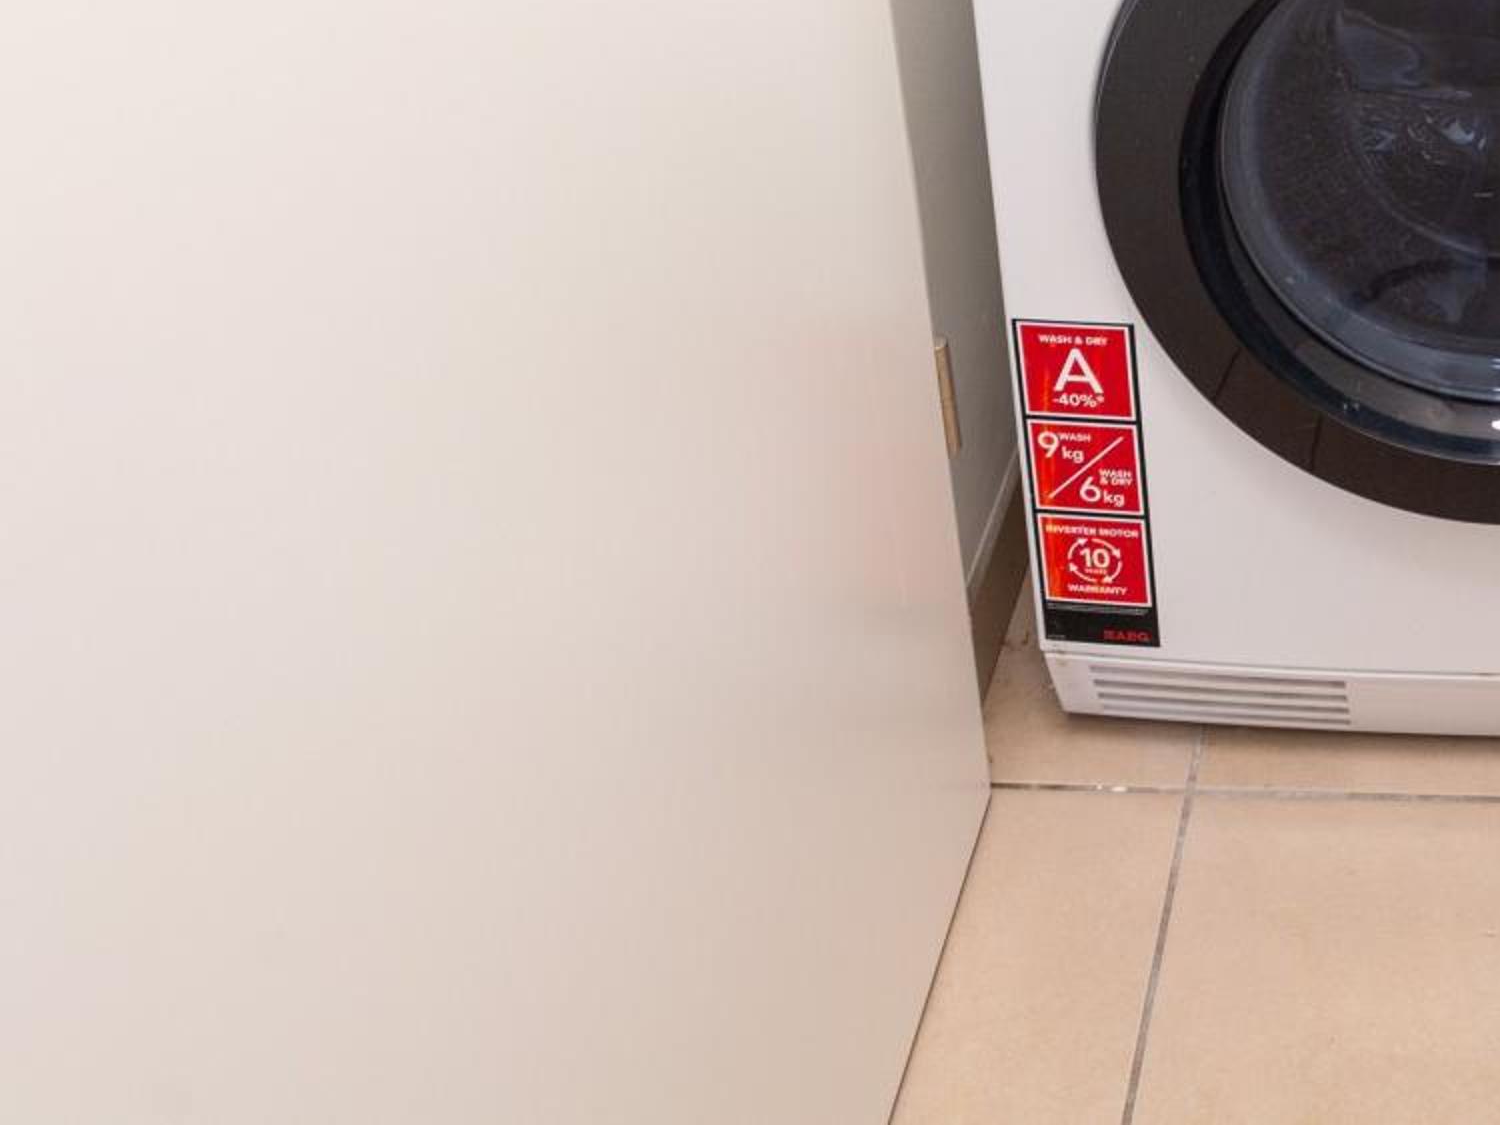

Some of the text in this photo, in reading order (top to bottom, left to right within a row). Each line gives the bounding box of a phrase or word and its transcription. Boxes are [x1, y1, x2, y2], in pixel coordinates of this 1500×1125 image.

[1038, 334, 1109, 346] WASH & DRY
[1053, 347, 1104, 394] A
[1037, 430, 1059, 458] 9
[1058, 432, 1091, 443] WASH
[1062, 446, 1085, 463] kg
[1099, 468, 1131, 479] WASH
[1111, 478, 1133, 486] DRY
[1079, 476, 1125, 507] 6 kg
[1046, 524, 1139, 539] INVERTER MOTOR
[1079, 546, 1111, 569] 10
[1067, 583, 1127, 596] WARRANTY
